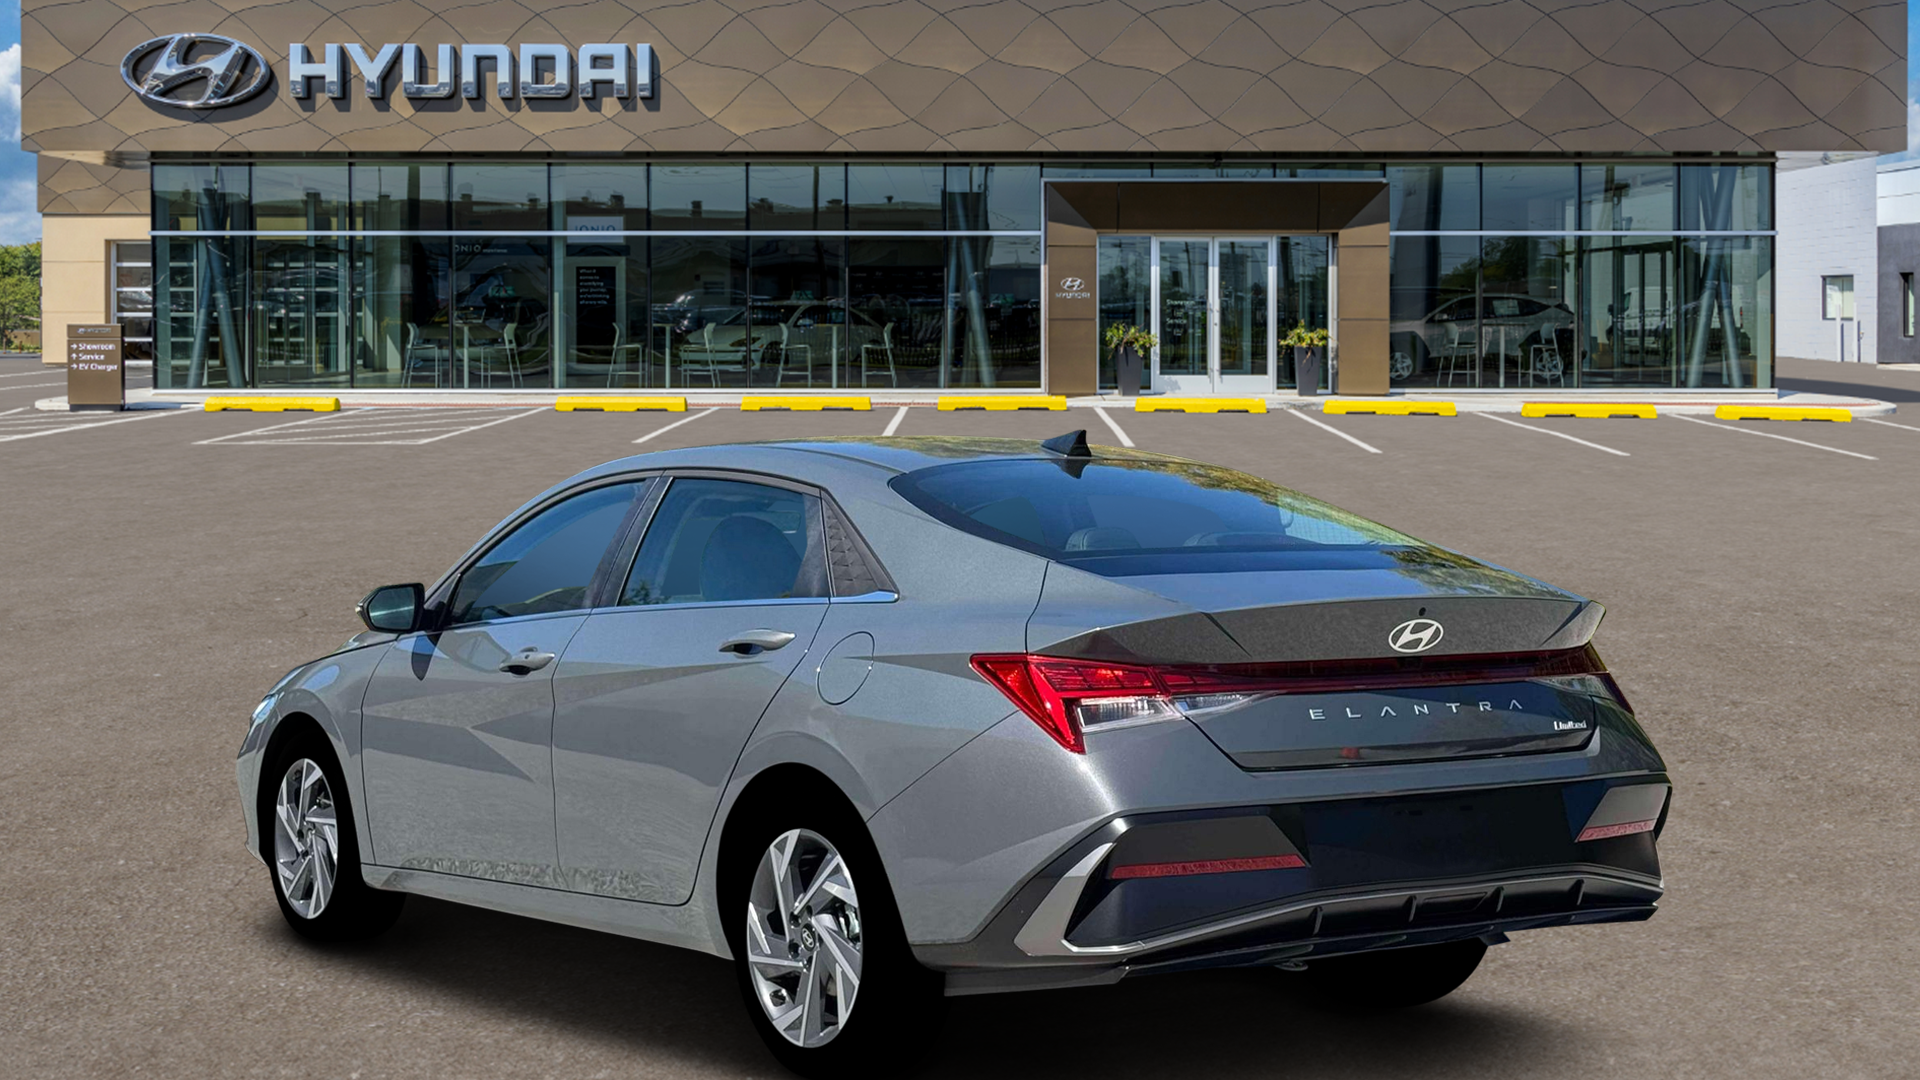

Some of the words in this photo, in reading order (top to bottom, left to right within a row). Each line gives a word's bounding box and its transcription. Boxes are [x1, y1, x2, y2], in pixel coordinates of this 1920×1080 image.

[289, 43, 654, 99] HYUNDAI
[78, 352, 105, 360] Service
[90, 363, 118, 372] Charger
[1309, 700, 1523, 720] ELANTRA
[1553, 720, 1587, 731] Limited
